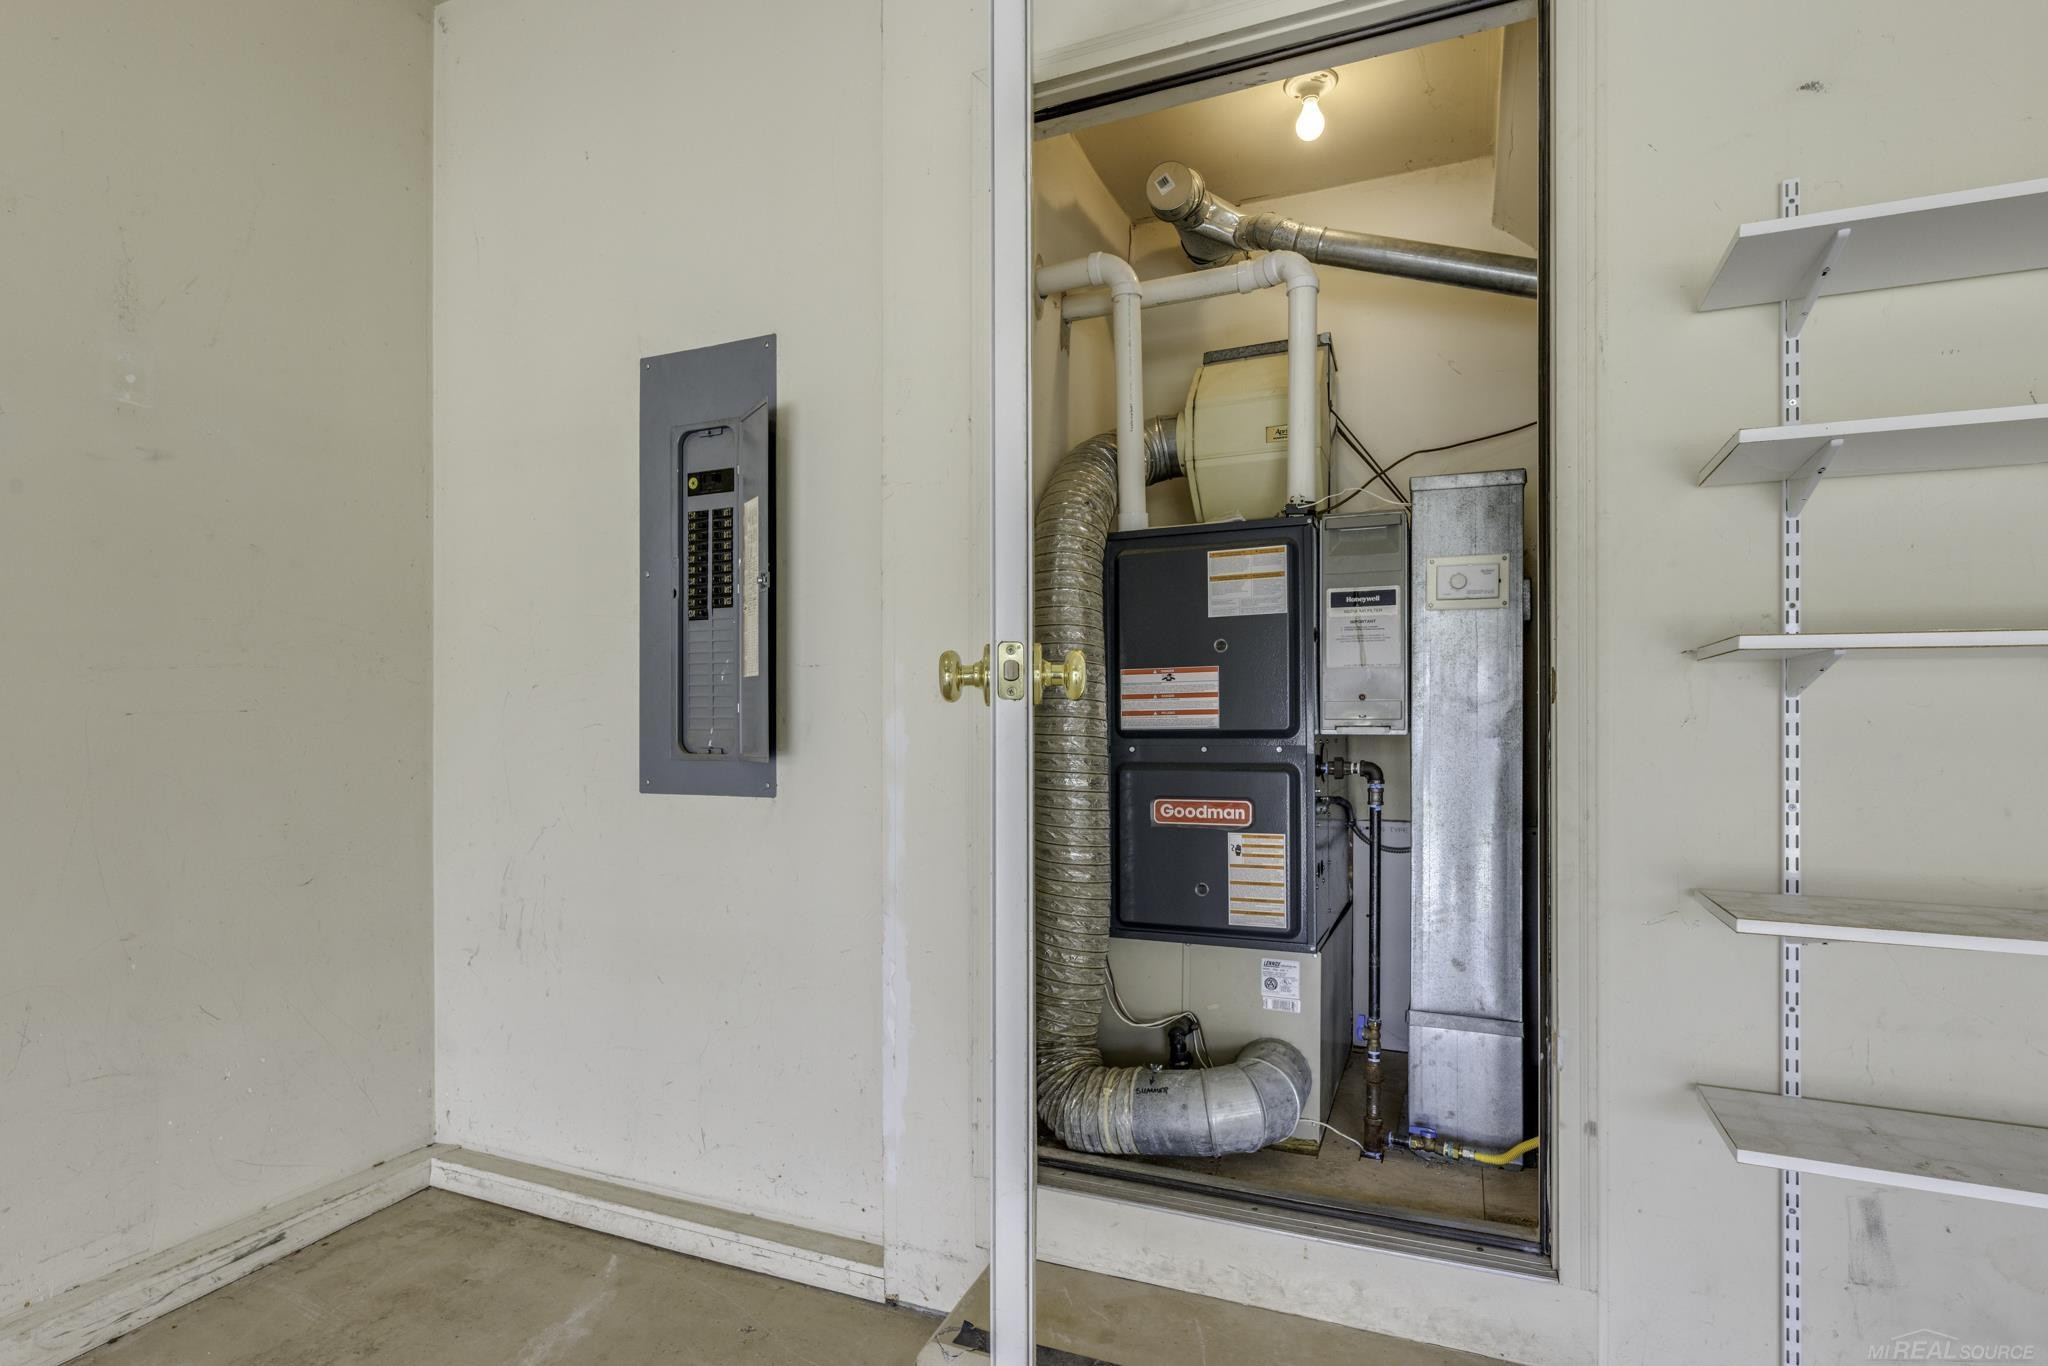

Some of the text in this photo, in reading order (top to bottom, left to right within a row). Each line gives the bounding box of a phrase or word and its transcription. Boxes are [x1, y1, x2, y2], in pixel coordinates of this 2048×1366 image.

[1346, 595, 1380, 603] Honeywell
[1160, 803, 1245, 820] Goodman
[1135, 1086, 1169, 1095] SUMMER
